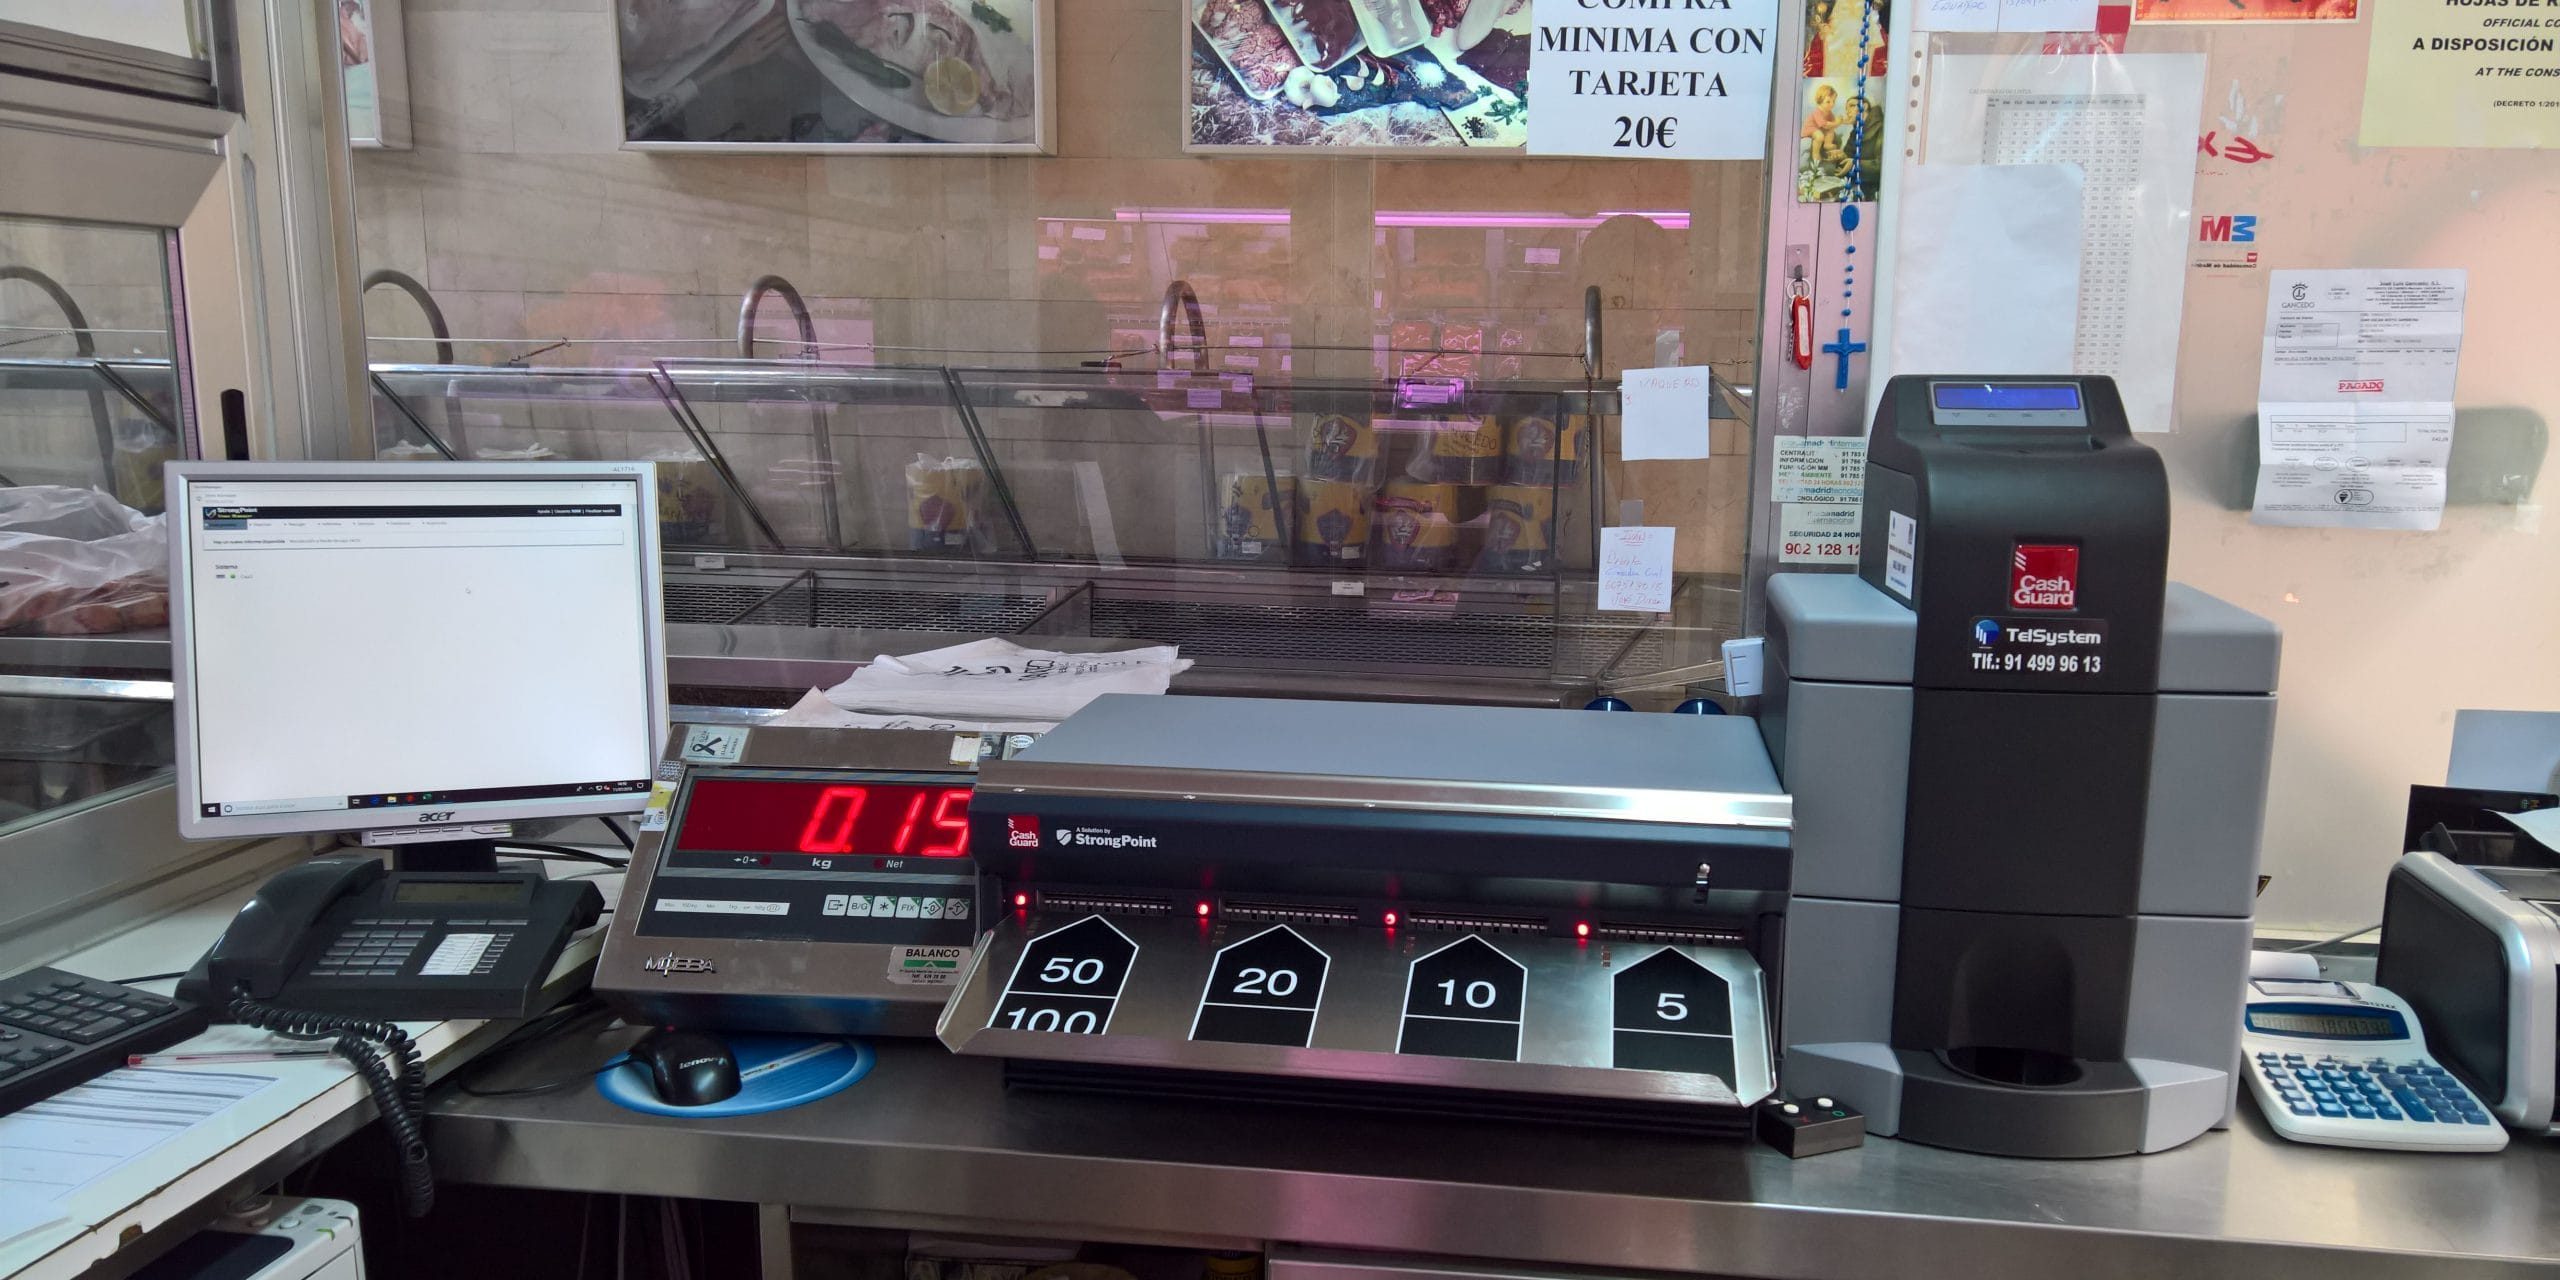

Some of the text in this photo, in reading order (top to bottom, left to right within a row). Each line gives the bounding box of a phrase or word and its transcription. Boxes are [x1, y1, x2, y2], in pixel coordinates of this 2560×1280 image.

[2483, 18, 2540, 28] OFFICIAL
[1538, 26, 1767, 54] MINIMA CON
[2412, 37, 2425, 50] A
[2431, 36, 2554, 51] DISPOSICIÓN
[2475, 67, 2494, 76] AT
[2497, 67, 2522, 77] THE
[1568, 70, 1729, 97] TARJETA
[1613, 116, 1678, 148] 20€
[2338, 381, 2384, 390] PAGADO
[1785, 542, 1811, 555] 902
[1817, 543, 1842, 555] 128
[2020, 575, 2071, 592] Cash
[2014, 588, 2074, 606] Guard
[2006, 628, 2101, 646] TelSystem
[1972, 652, 2101, 673] Tlf.: 91 499 96 13
[419, 811, 456, 823] acer
[1009, 838, 1039, 848] Guard
[1011, 830, 1036, 841] Cash
[1075, 833, 1158, 849] StrongPoint
[812, 857, 832, 869] kg
[886, 859, 904, 869] Net
[851, 901, 868, 911] B/G
[901, 903, 915, 912] FIX
[905, 948, 960, 958] BALANCO
[1039, 957, 1105, 985] 50
[1232, 967, 1298, 997] 20
[1437, 978, 1498, 1009] 10
[1656, 992, 1688, 1021] 5
[1006, 1007, 1097, 1034] 100
